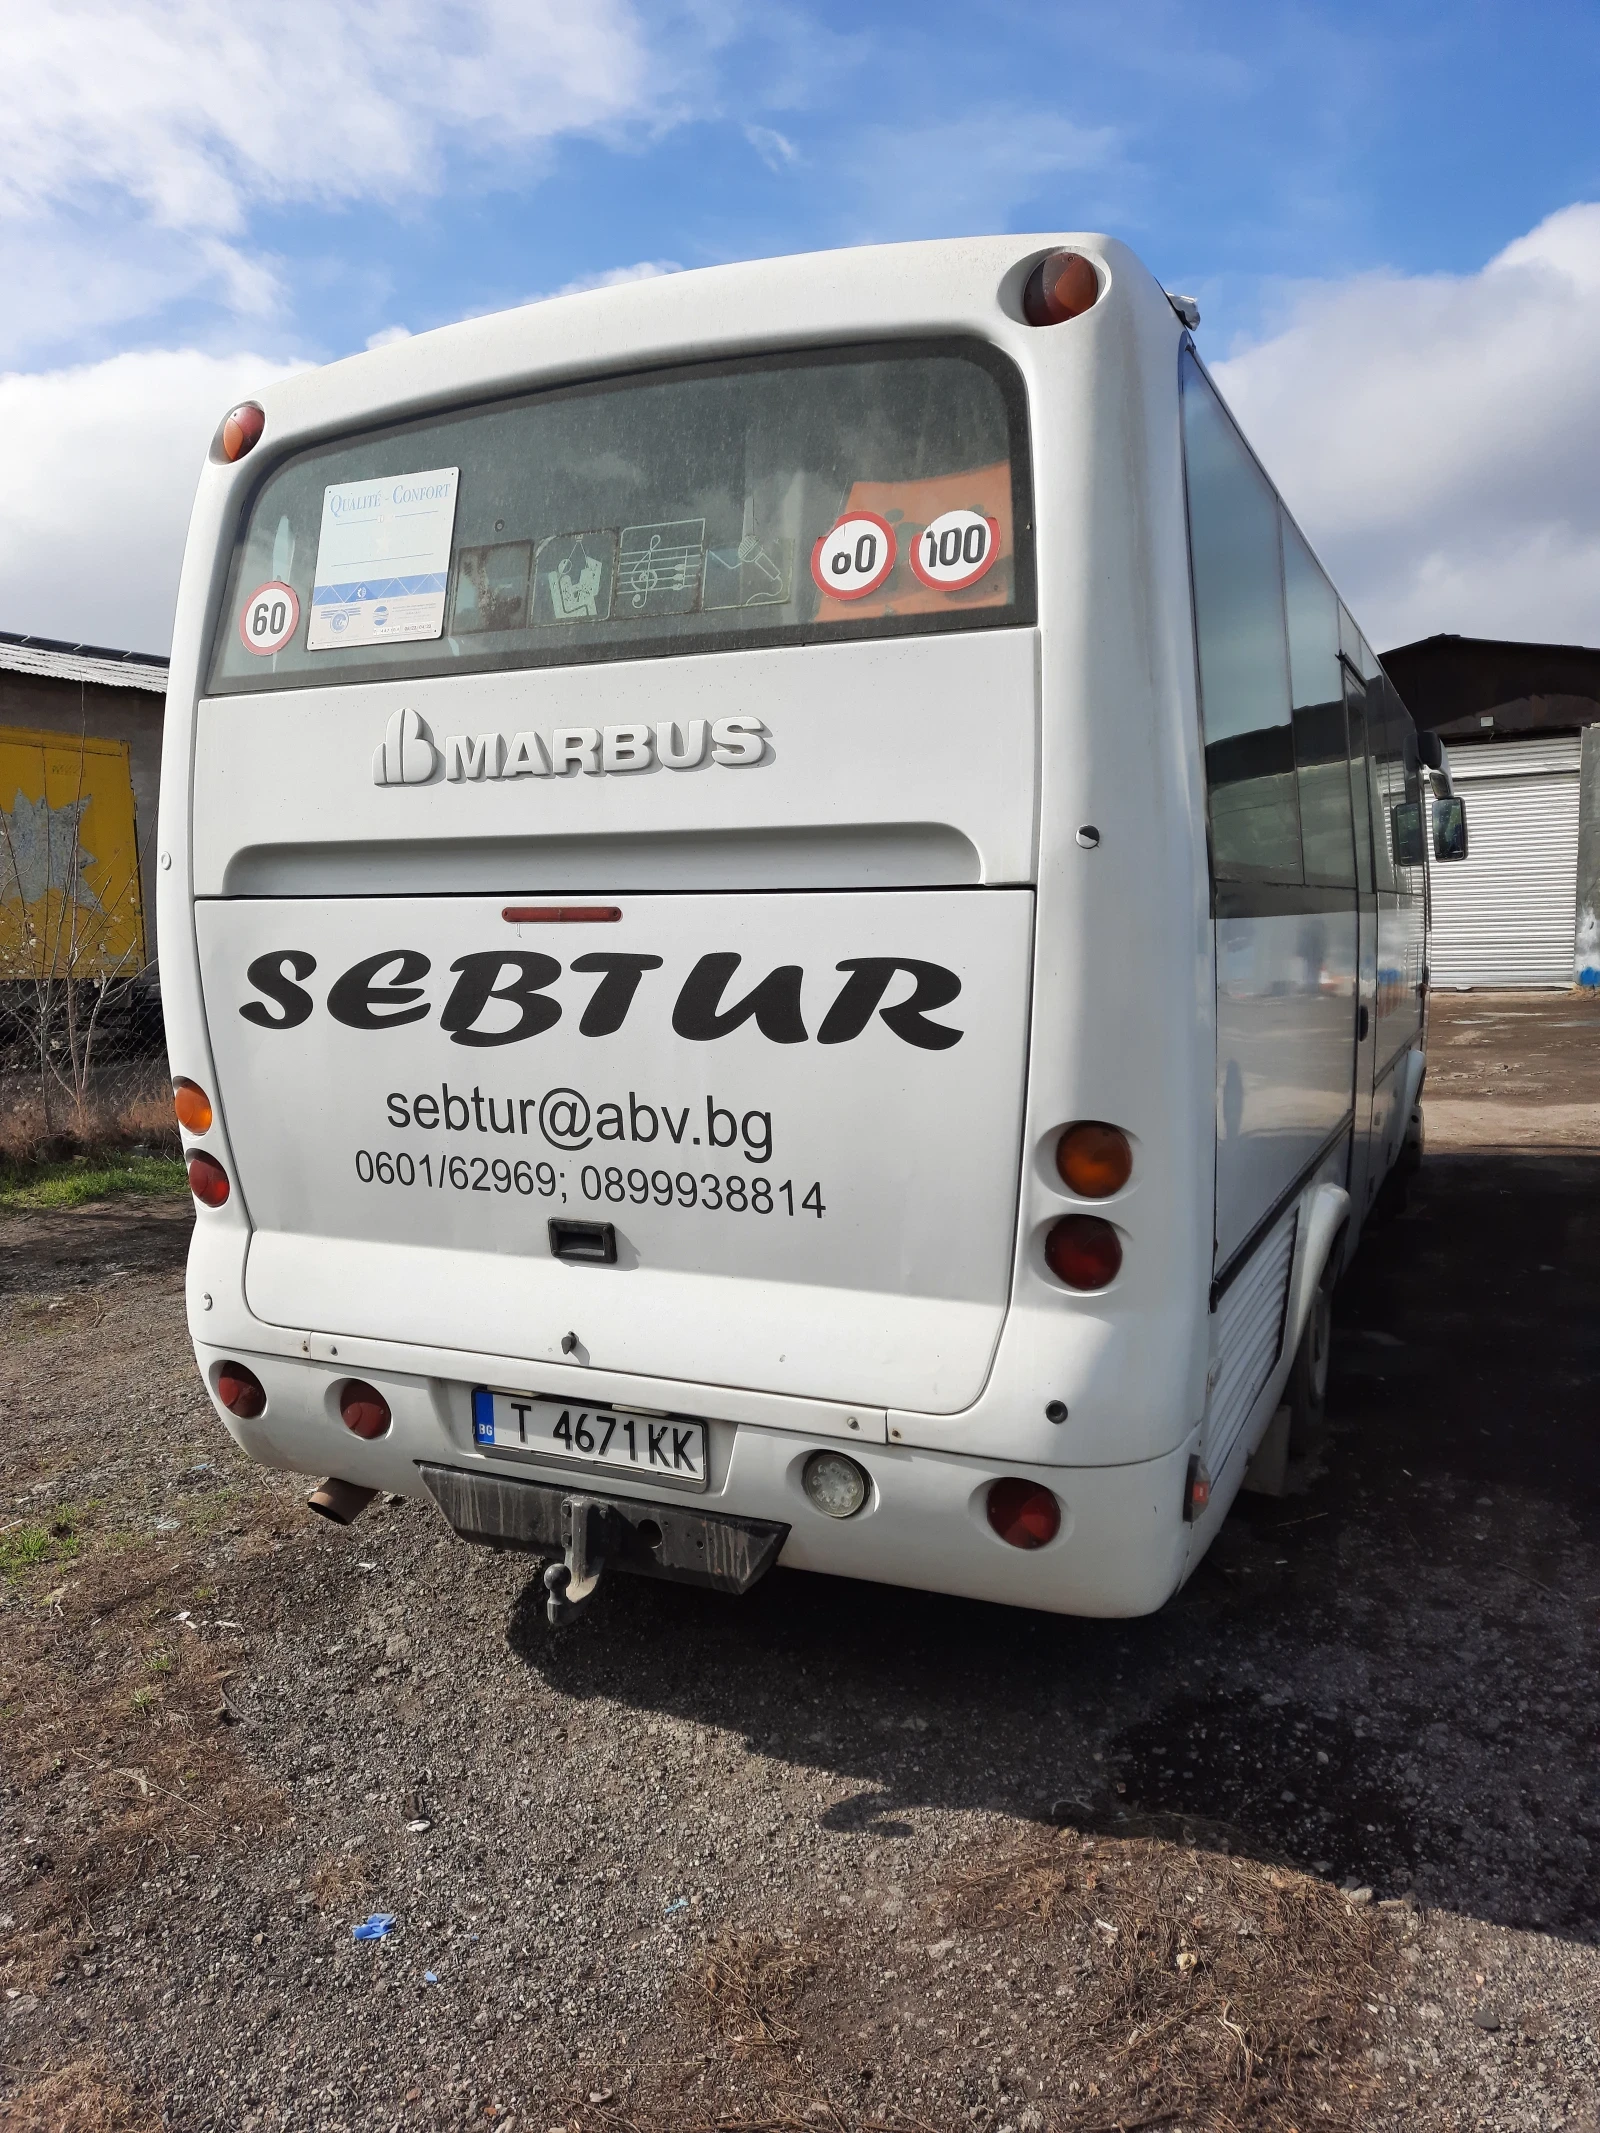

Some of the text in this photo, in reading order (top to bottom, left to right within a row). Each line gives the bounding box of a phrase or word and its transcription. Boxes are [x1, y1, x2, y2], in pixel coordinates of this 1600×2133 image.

[392, 484, 451, 505] CONFORT
[925, 523, 986, 568] 100
[253, 602, 287, 636] 60
[445, 715, 770, 783] MARBUS
[238, 949, 965, 1051] SEBTUR
[386, 1082, 773, 1164] sebtur@abv.bg
[354, 1148, 828, 1220] 0601/62969; 0899938814
[479, 1424, 493, 1436] BG
[510, 1402, 532, 1443] T
